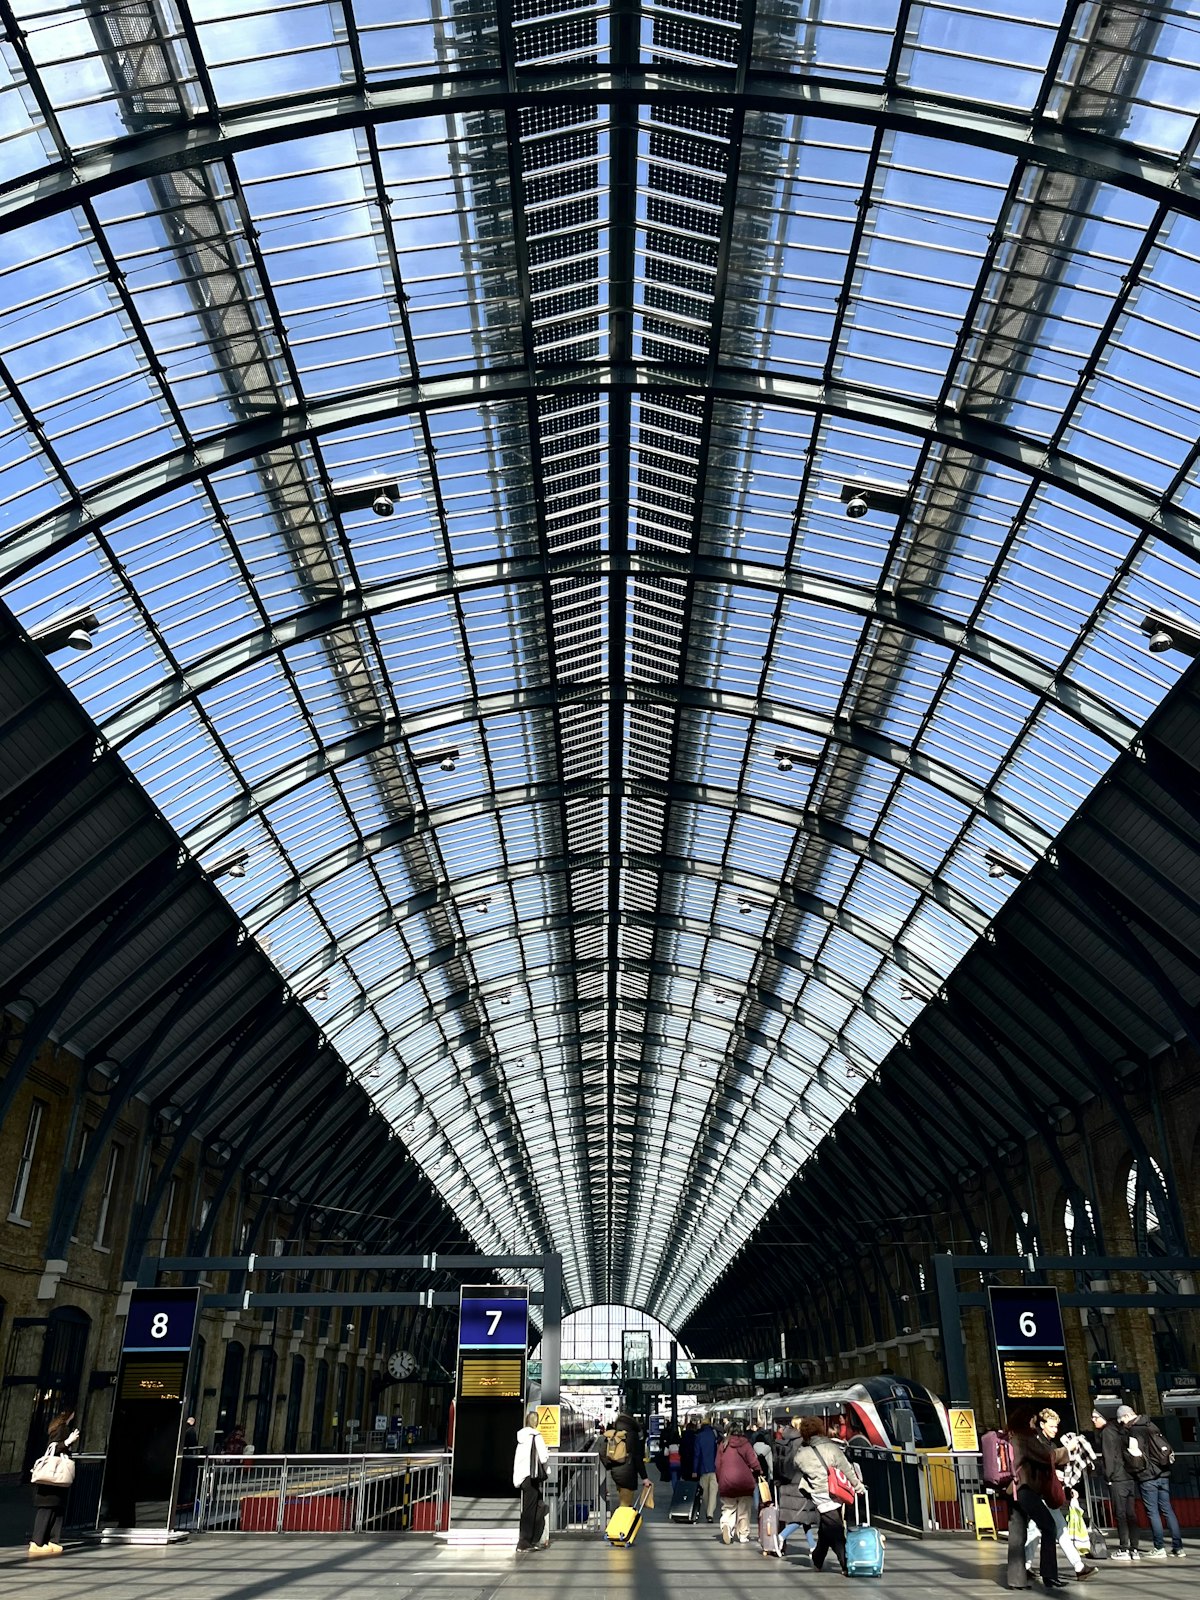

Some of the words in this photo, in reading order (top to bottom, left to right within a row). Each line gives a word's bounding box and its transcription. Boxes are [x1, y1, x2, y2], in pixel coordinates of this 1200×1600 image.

[151, 1312, 169, 1338] 8
[485, 1310, 502, 1336] 7
[1019, 1311, 1037, 1338] 6
